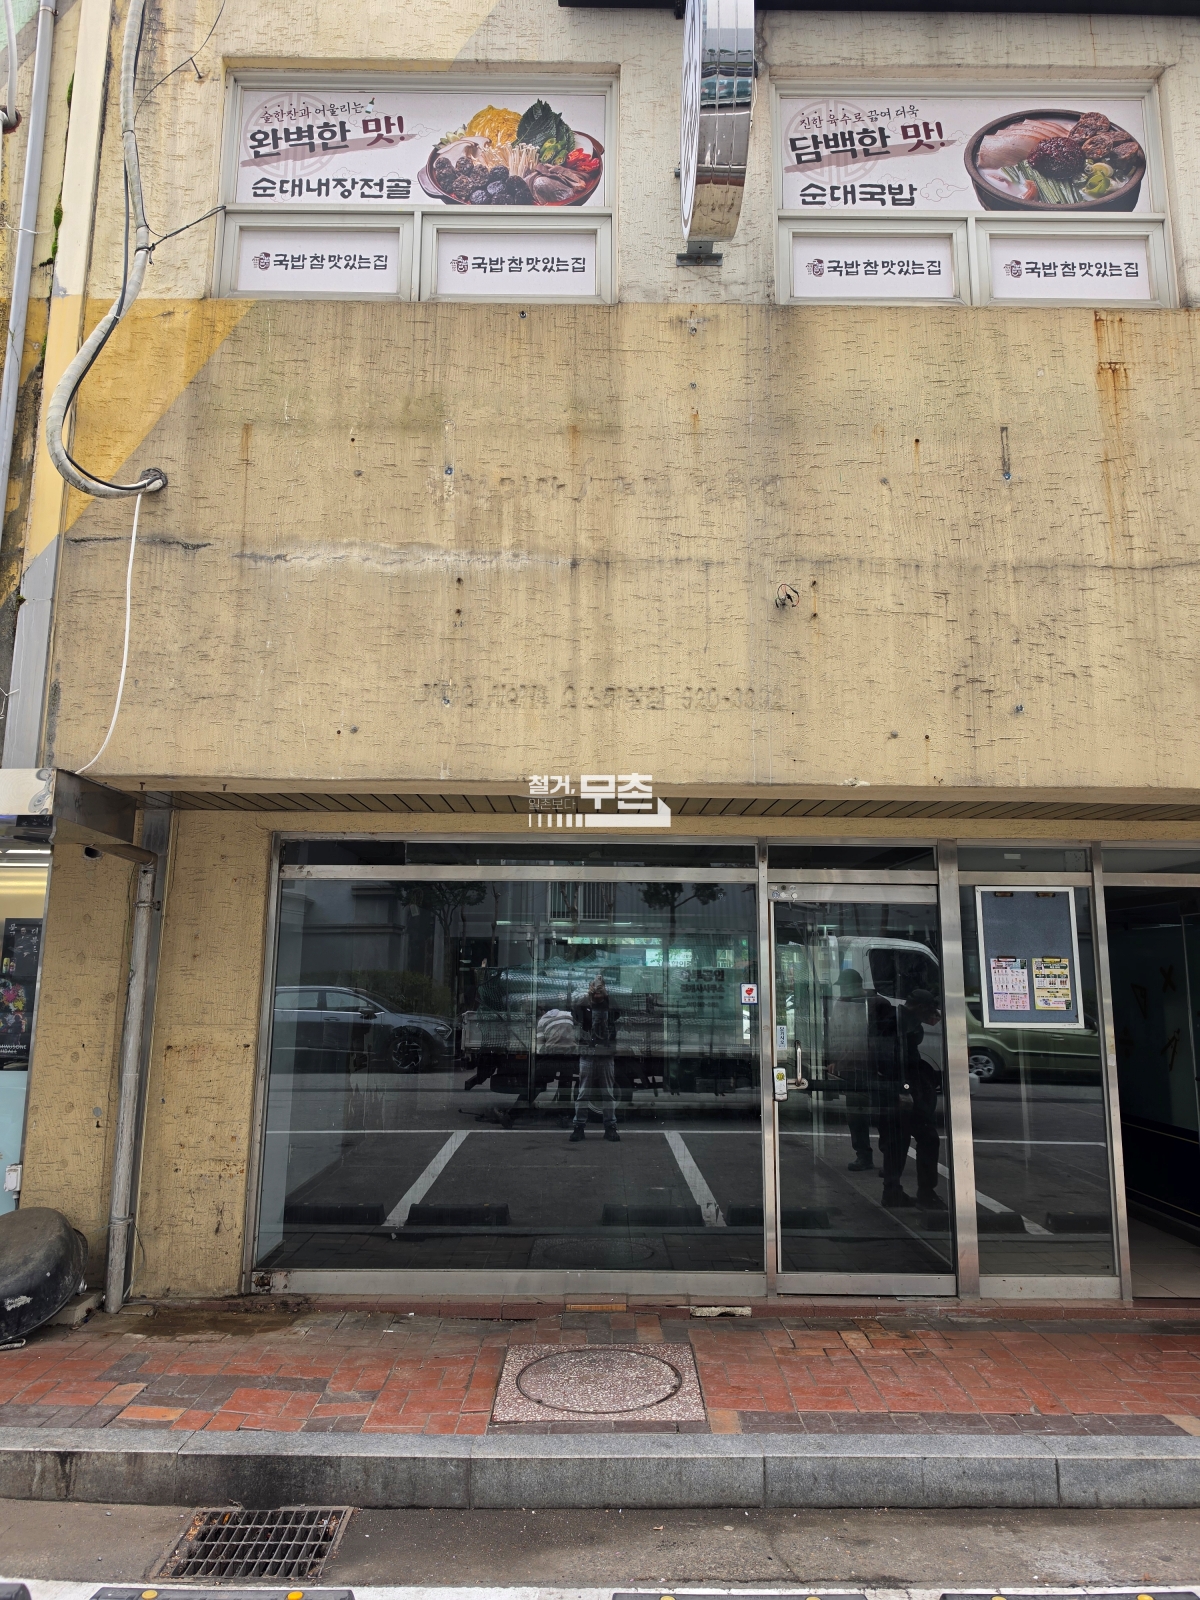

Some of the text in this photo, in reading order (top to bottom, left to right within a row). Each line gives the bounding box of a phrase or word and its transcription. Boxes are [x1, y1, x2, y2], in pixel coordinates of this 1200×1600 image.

[314, 102, 365, 117] 어울리는
[800, 116, 823, 130] 진한
[826, 112, 866, 127] 육수로
[895, 104, 920, 119] 더욱
[249, 115, 406, 159] 완벽한 맛!
[789, 121, 946, 165] 담백한 맛!
[251, 177, 412, 200] 순대내장전골
[799, 183, 918, 207] 순대국밥
[272, 253, 307, 271] 국밥
[309, 253, 326, 271] 참
[471, 256, 505, 274] 국밥
[507, 256, 524, 273] 참
[826, 259, 860, 277] 국밥
[862, 259, 879, 276] 참
[1024, 261, 1058, 278] 국밥
[1060, 260, 1077, 277] 참
